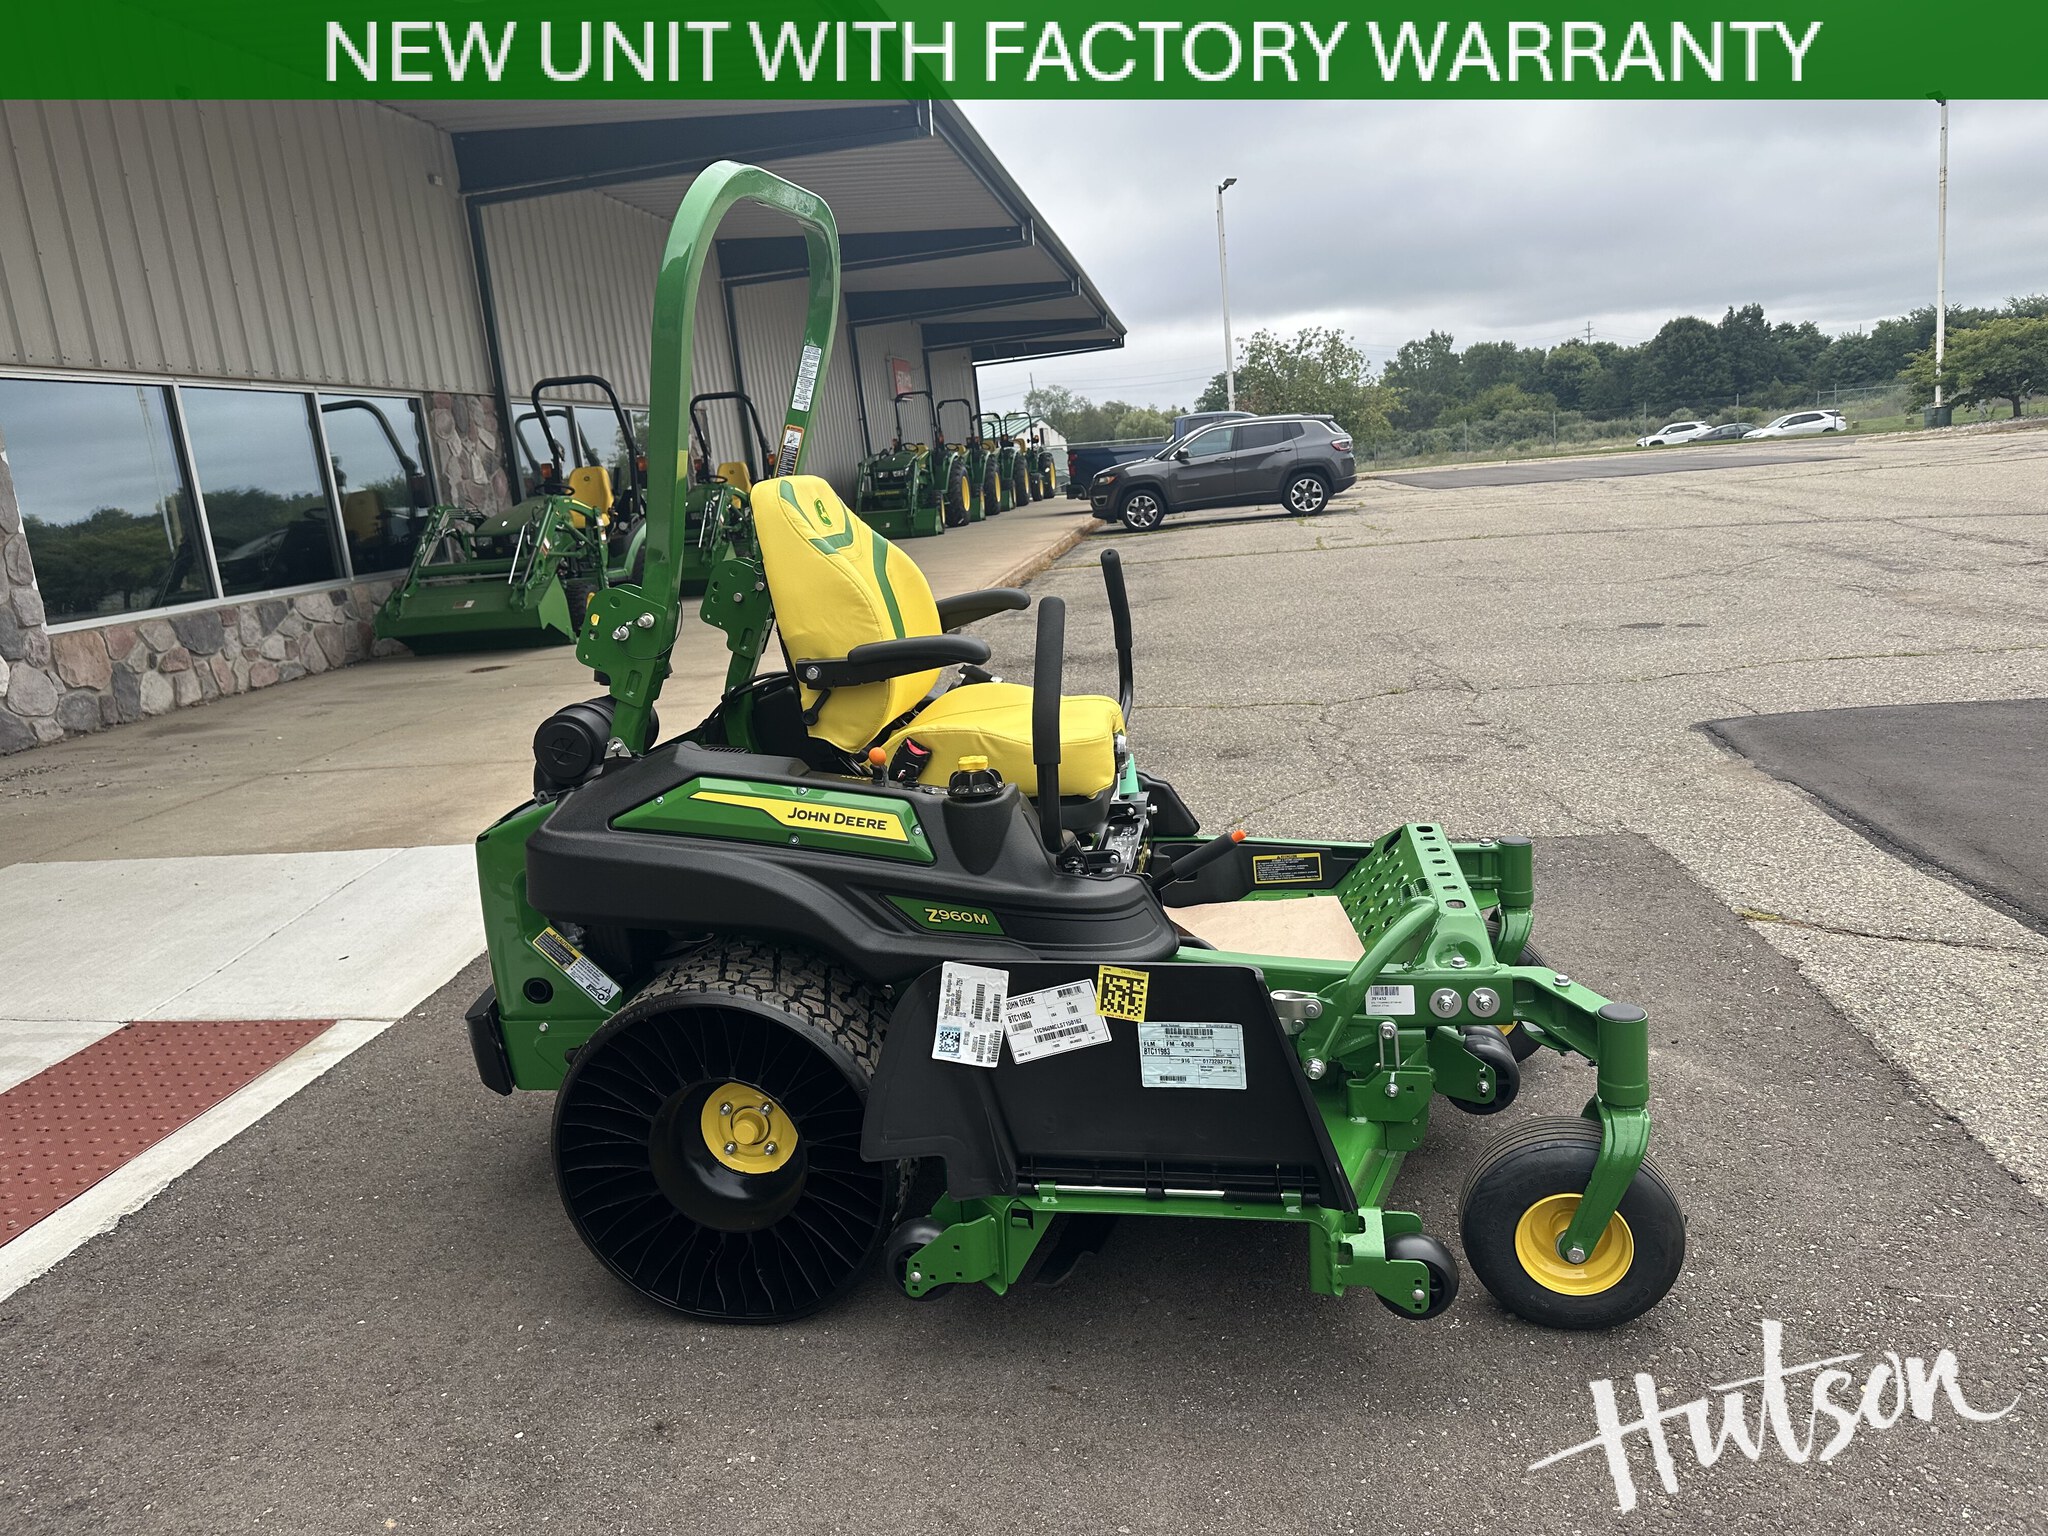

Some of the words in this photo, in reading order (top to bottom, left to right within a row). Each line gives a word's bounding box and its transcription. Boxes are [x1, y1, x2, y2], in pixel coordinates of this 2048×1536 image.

[787, 807, 830, 825] JOHN
[833, 812, 888, 831] DEERE
[924, 908, 990, 925] Z960M
[556, 936, 574, 952] CAUTION
[1006, 999, 1019, 1010] JOHN
[1019, 996, 1036, 1007] DEERE
[1008, 1011, 1031, 1023] BTC11983
[1144, 1047, 1170, 1055] BTC11983
